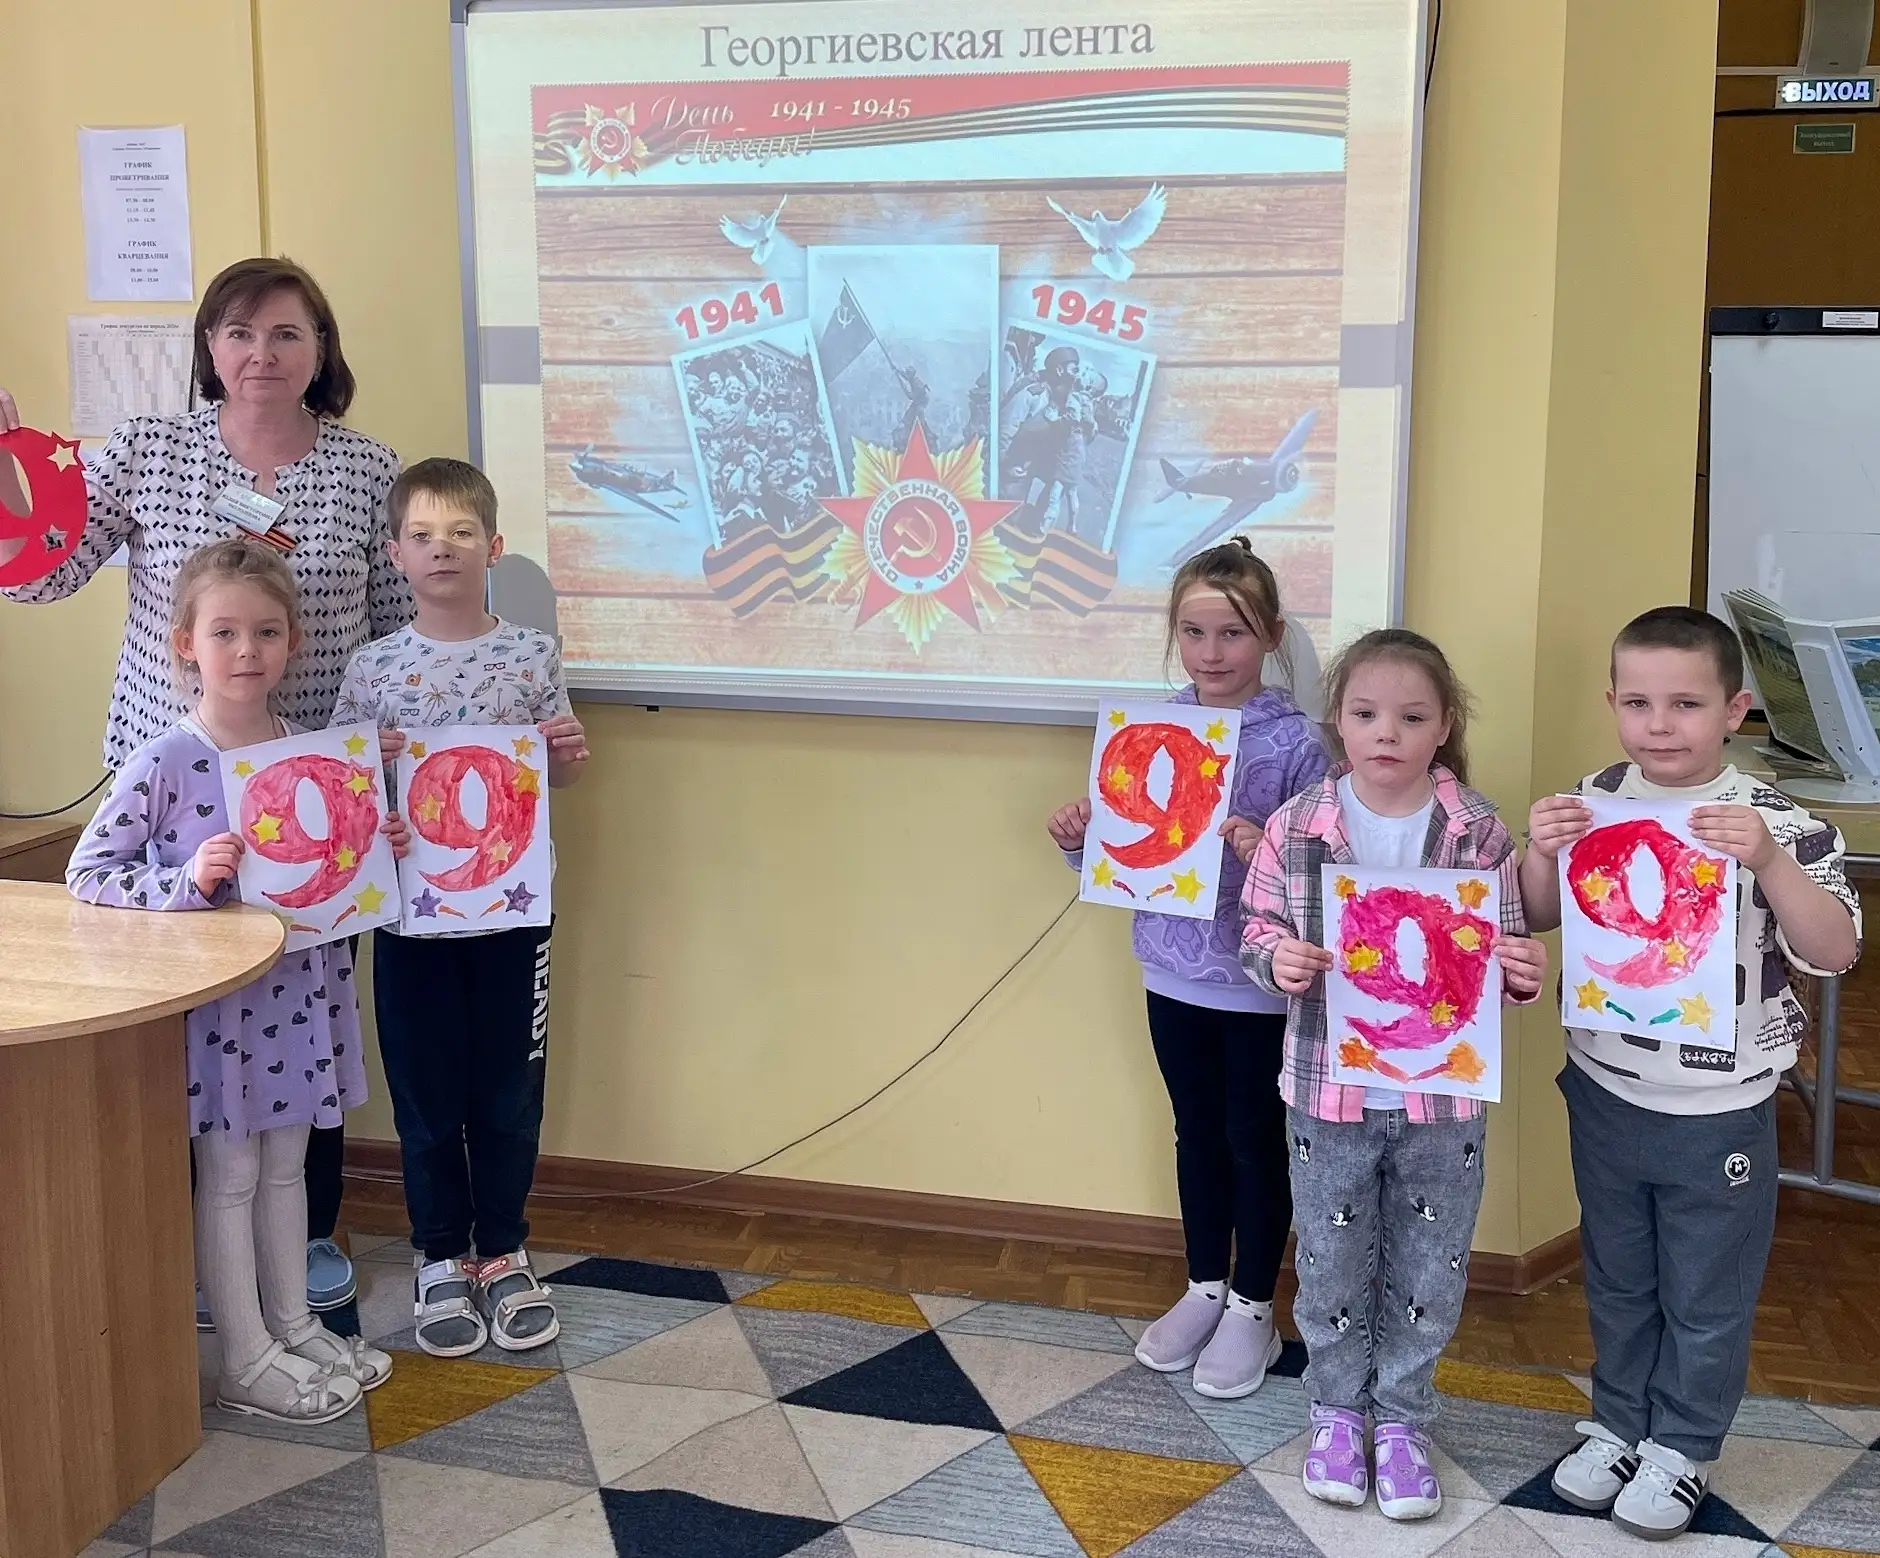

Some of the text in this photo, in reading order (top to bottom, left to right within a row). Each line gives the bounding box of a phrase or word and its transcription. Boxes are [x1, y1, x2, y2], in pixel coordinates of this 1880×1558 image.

[699, 22, 1157, 77] Георгиевская лента
[651, 96, 734, 130] День
[770, 100, 826, 122] 1941
[850, 98, 912, 120] 1945
[1783, 81, 1870, 102] ВЫХОД
[124, 161, 153, 169] ГРАФИК
[675, 126, 816, 168] Победы!
[128, 240, 158, 248] ГРАФИК
[674, 282, 785, 341] 1941
[1031, 283, 1148, 342] 1945
[868, 483, 969, 583] ОТЕЧЕСТВЕННАЯ ВОЙНА
[407, 744, 541, 892] 9
[1097, 722, 1232, 870] 9
[239, 753, 379, 909] 9
[1567, 819, 1728, 990] 9
[1336, 885, 1500, 1051] 9
